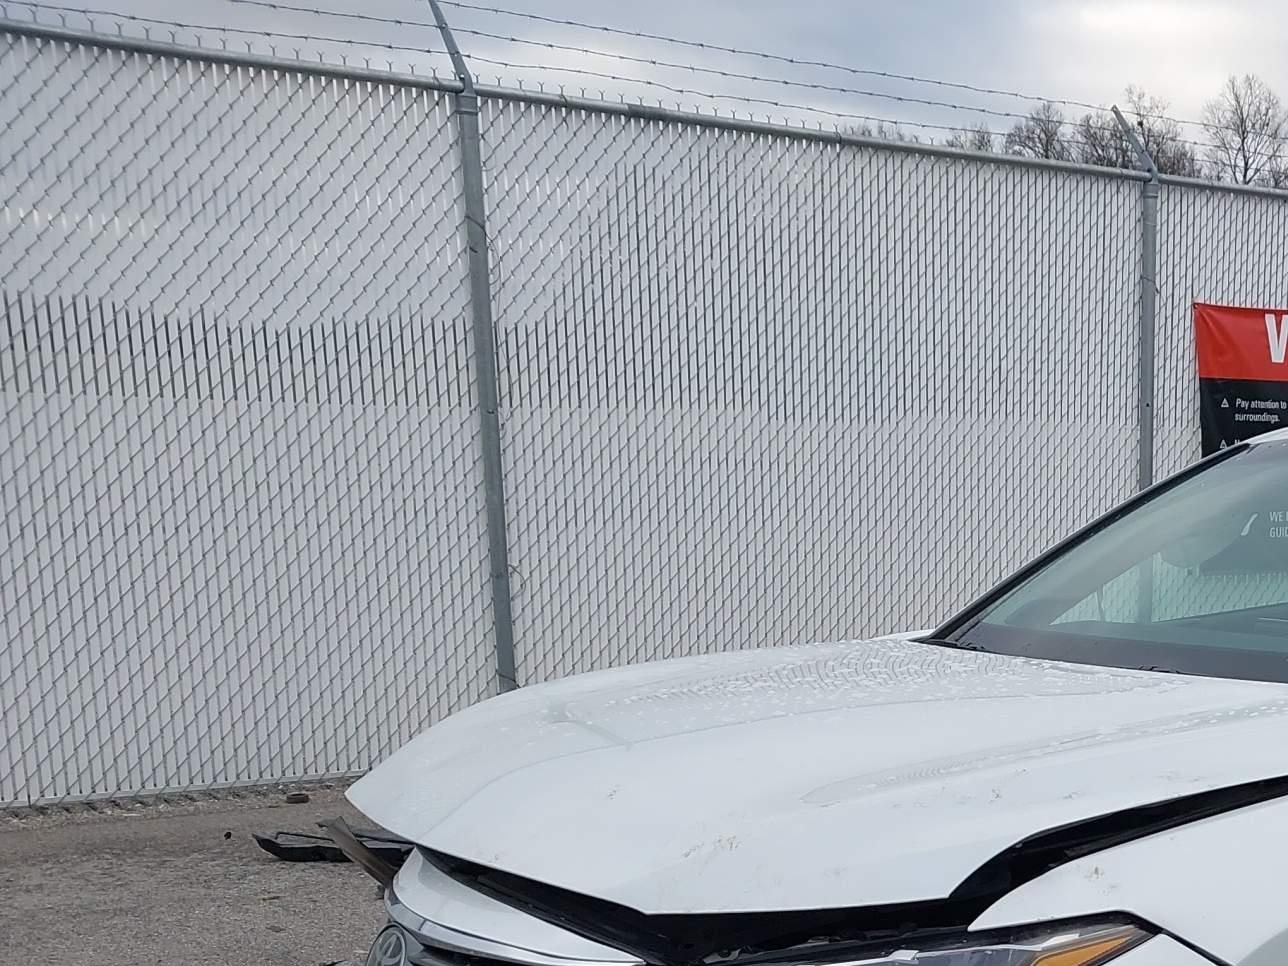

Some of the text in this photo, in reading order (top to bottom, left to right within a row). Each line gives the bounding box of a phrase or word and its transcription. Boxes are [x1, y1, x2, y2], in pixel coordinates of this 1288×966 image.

[1235, 398, 1249, 410] Pay
[1250, 399, 1279, 409] attention
[1280, 400, 1287, 409] to
[1234, 412, 1280, 424] surroundings.
[1269, 511, 1282, 522] WE
